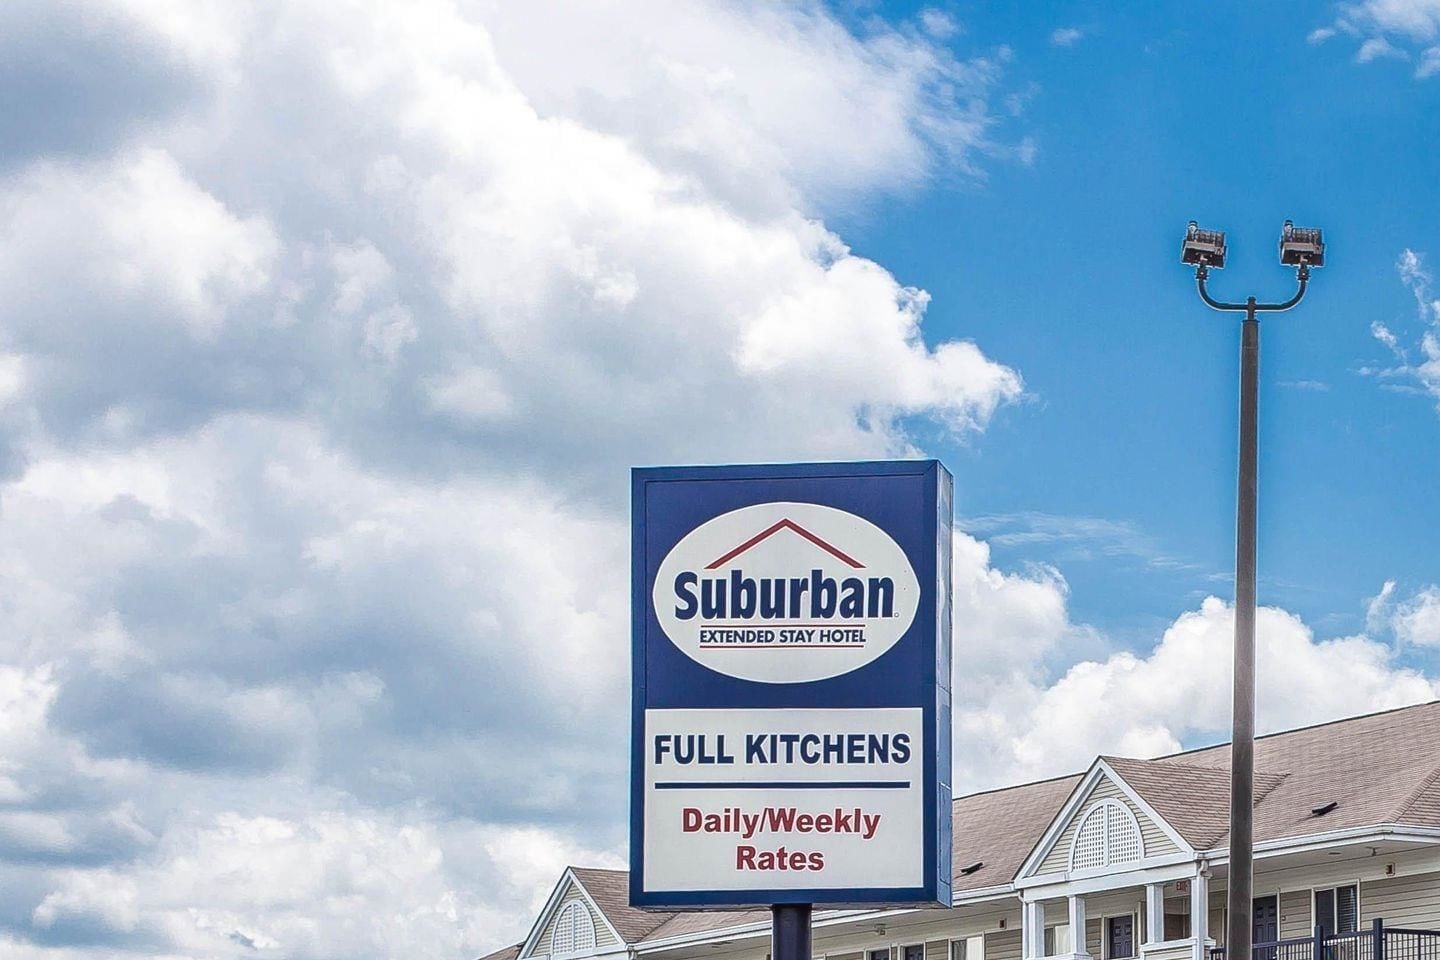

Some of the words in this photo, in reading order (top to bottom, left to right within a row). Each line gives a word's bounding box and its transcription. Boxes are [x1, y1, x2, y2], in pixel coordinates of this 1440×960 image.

[673, 569, 895, 621] Suburban
[699, 629, 775, 644] EXTENDED
[779, 629, 815, 643] STAY
[819, 628, 866, 643] HOTEL
[654, 733, 734, 765] FULL
[745, 733, 912, 765] KITCHENS
[681, 807, 882, 839] Daily/Weekly
[735, 845, 825, 872] Rates
